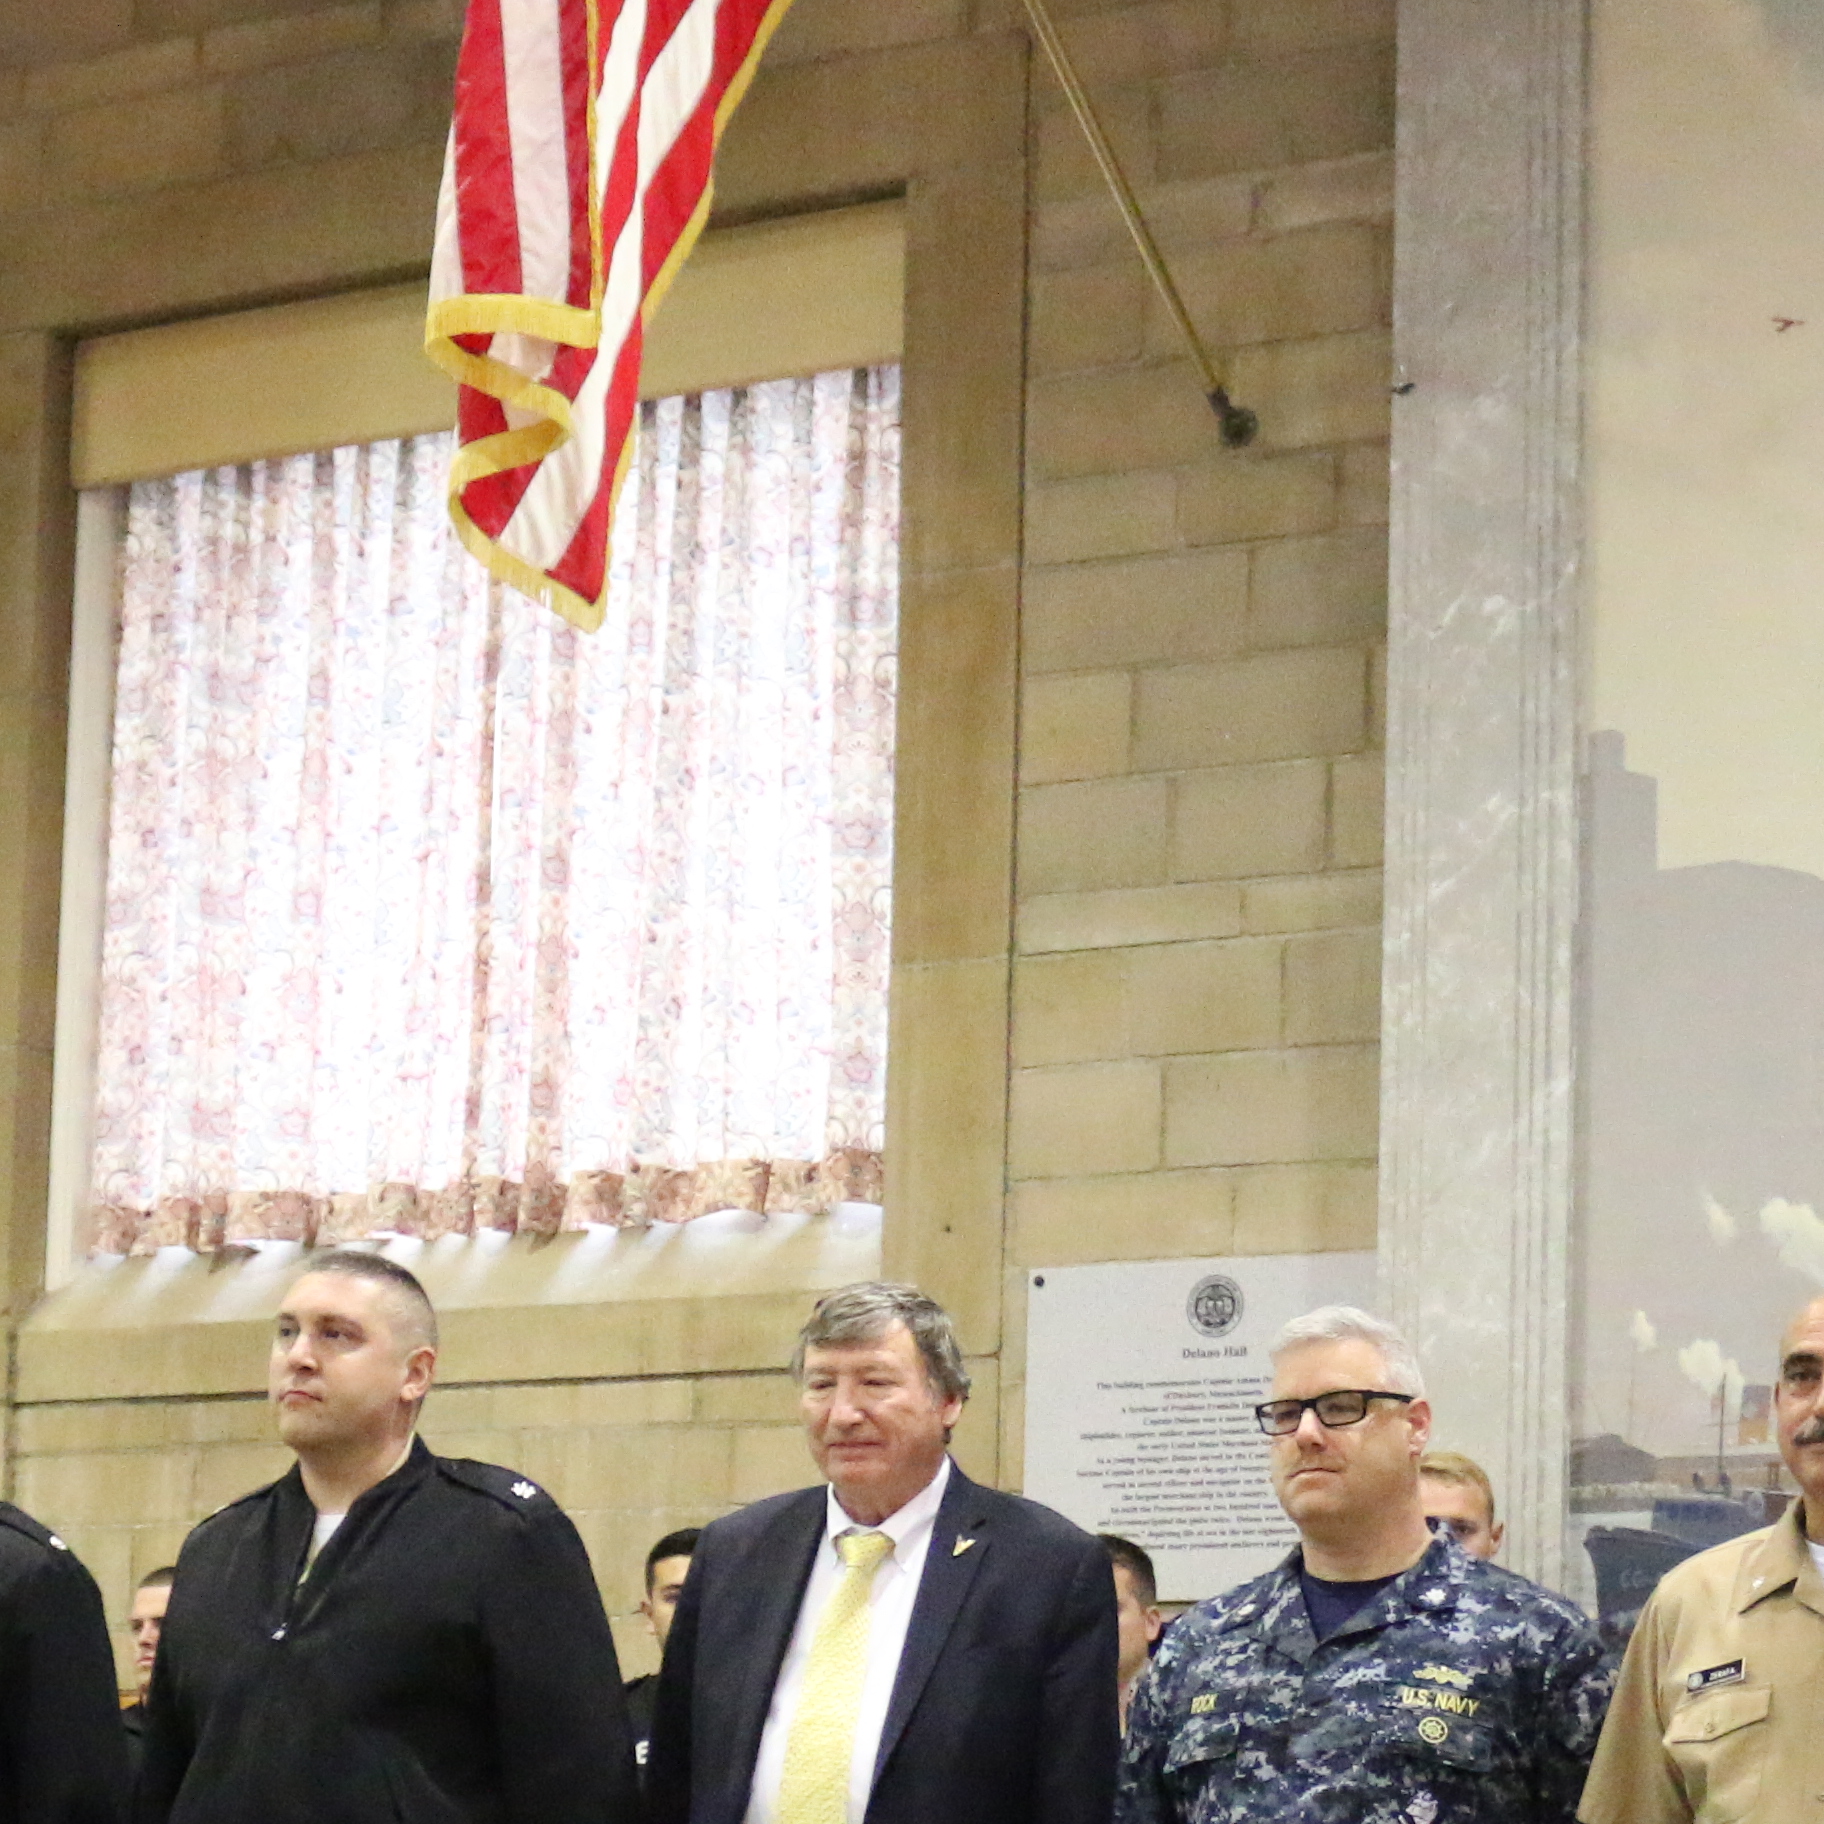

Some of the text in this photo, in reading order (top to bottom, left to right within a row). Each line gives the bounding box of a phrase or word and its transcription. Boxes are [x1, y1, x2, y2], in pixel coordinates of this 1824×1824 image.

[1182, 1345, 1248, 1359] Delano Hall
[1435, 1692, 1480, 1717] NAVY
